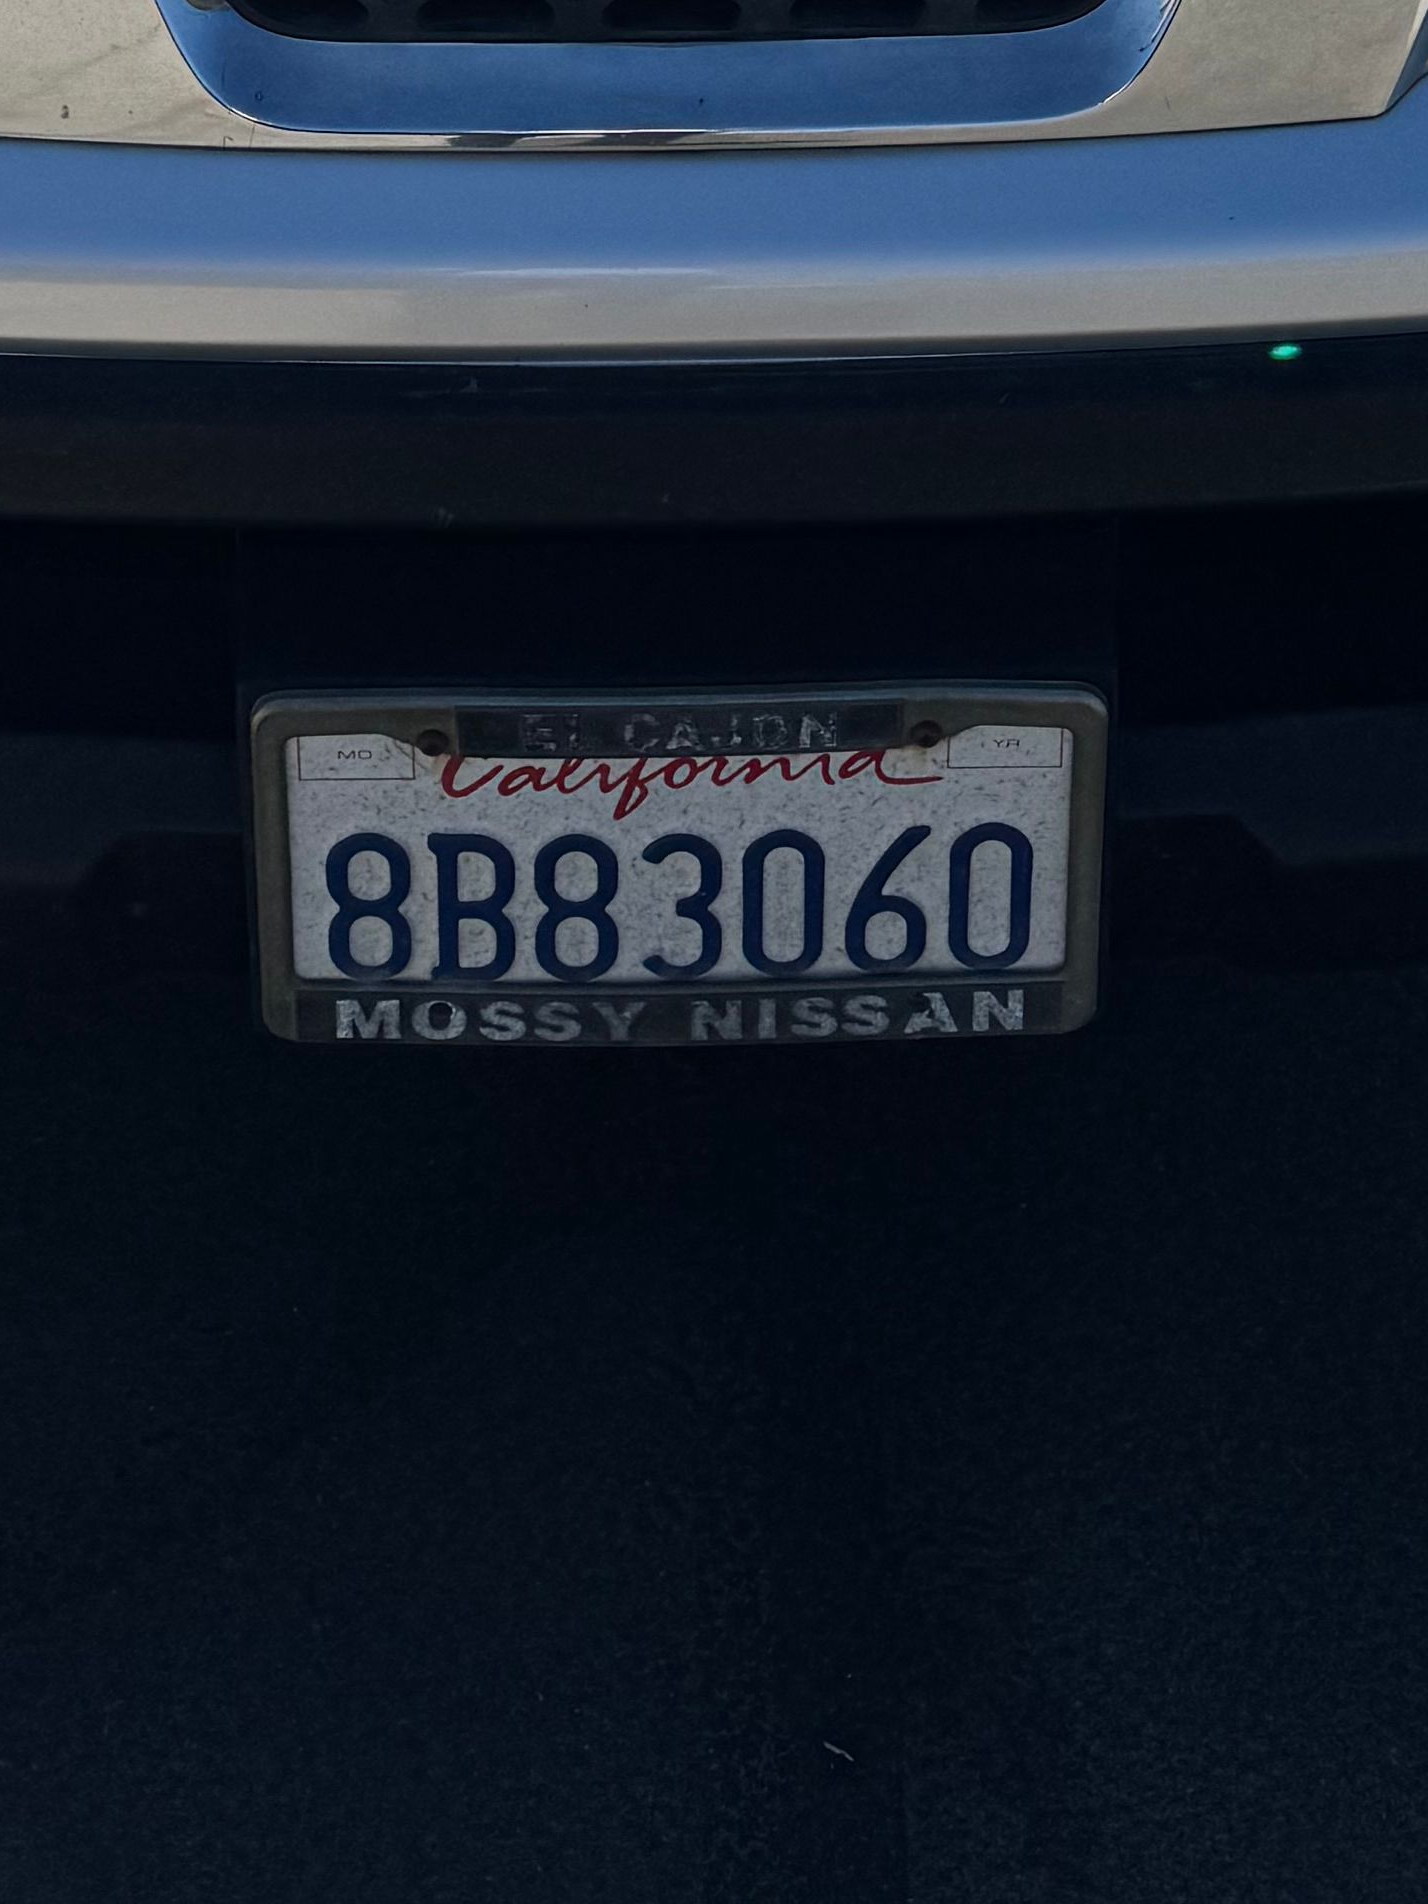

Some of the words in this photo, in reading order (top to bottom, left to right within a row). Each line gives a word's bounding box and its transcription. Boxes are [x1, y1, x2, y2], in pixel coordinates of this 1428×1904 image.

[337, 749, 372, 761] MO
[325, 822, 1034, 982] 8B83060
[334, 999, 649, 1043] MOSSY
[690, 989, 1025, 1042] NISSAN
